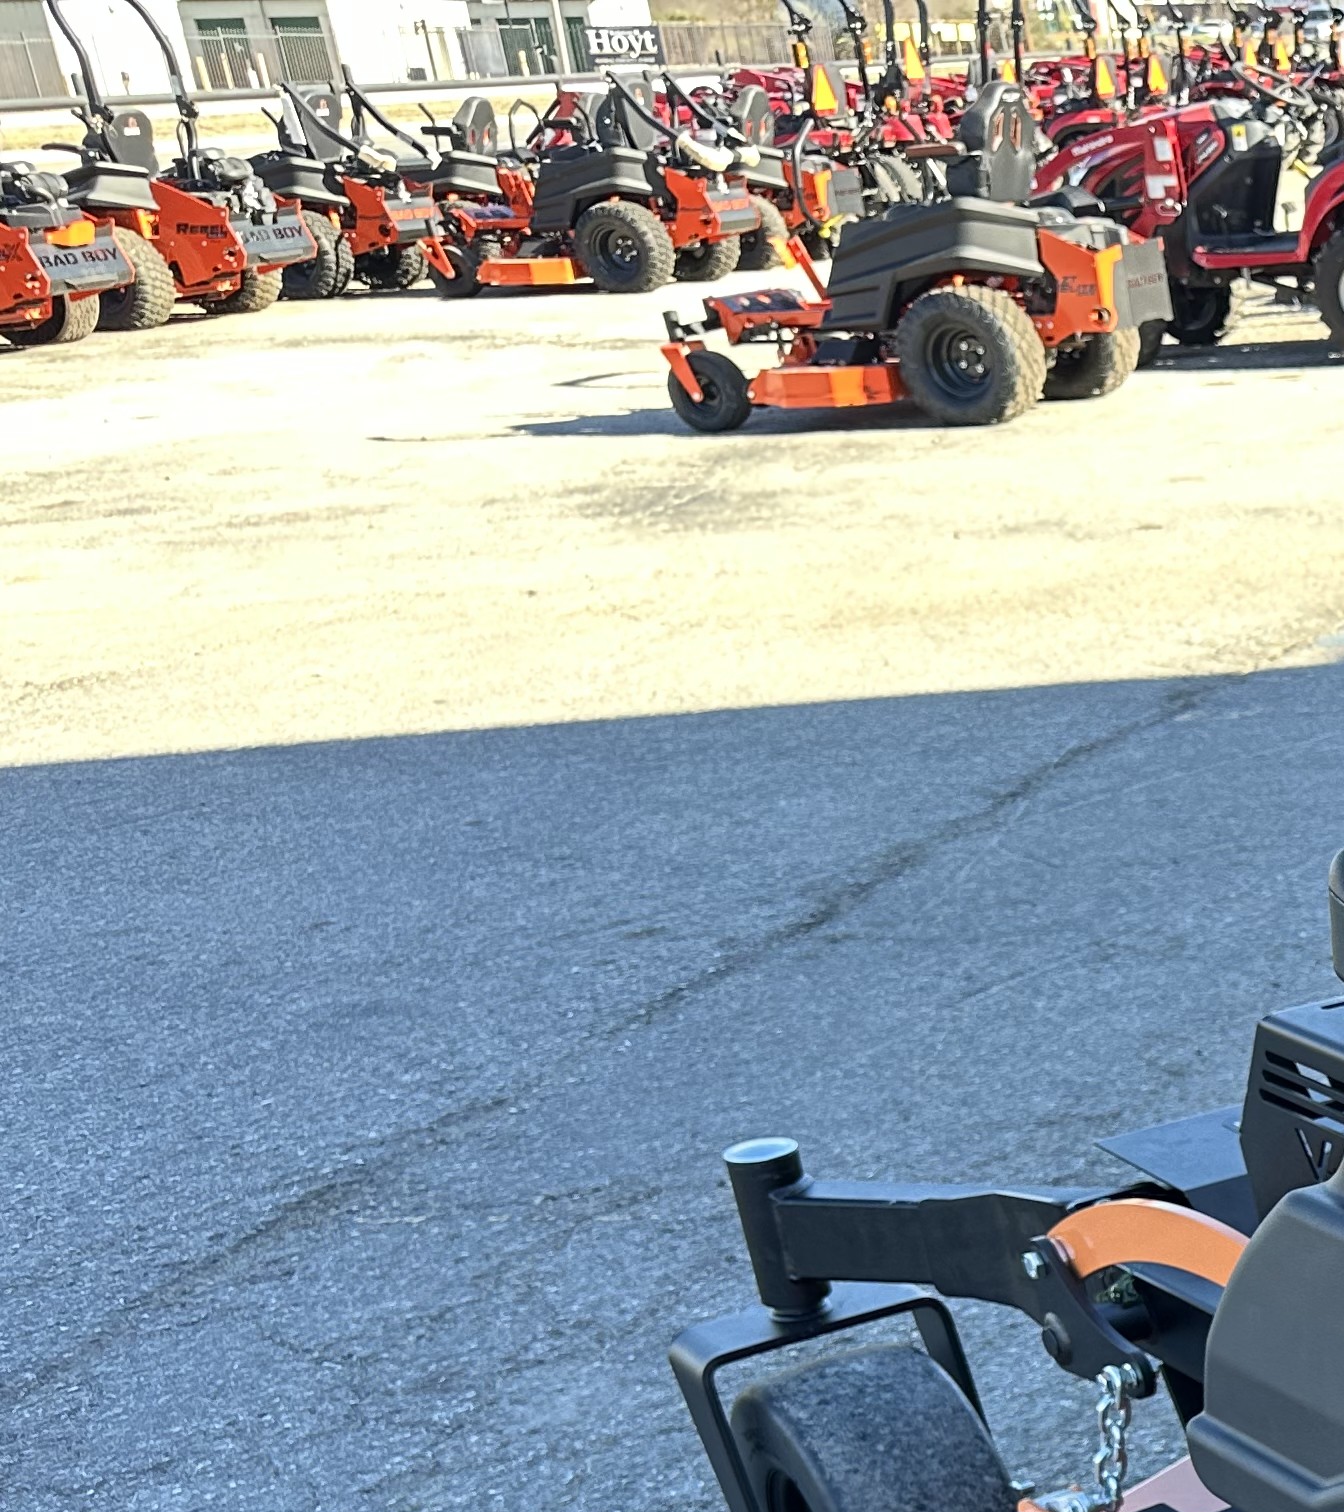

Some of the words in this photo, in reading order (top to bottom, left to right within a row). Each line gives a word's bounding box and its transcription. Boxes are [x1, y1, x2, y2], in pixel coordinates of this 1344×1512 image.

[585, 29, 658, 58] Hoyt
[272, 225, 303, 240] BOY
[40, 252, 79, 268] BAD
[81, 247, 118, 263] BOY
